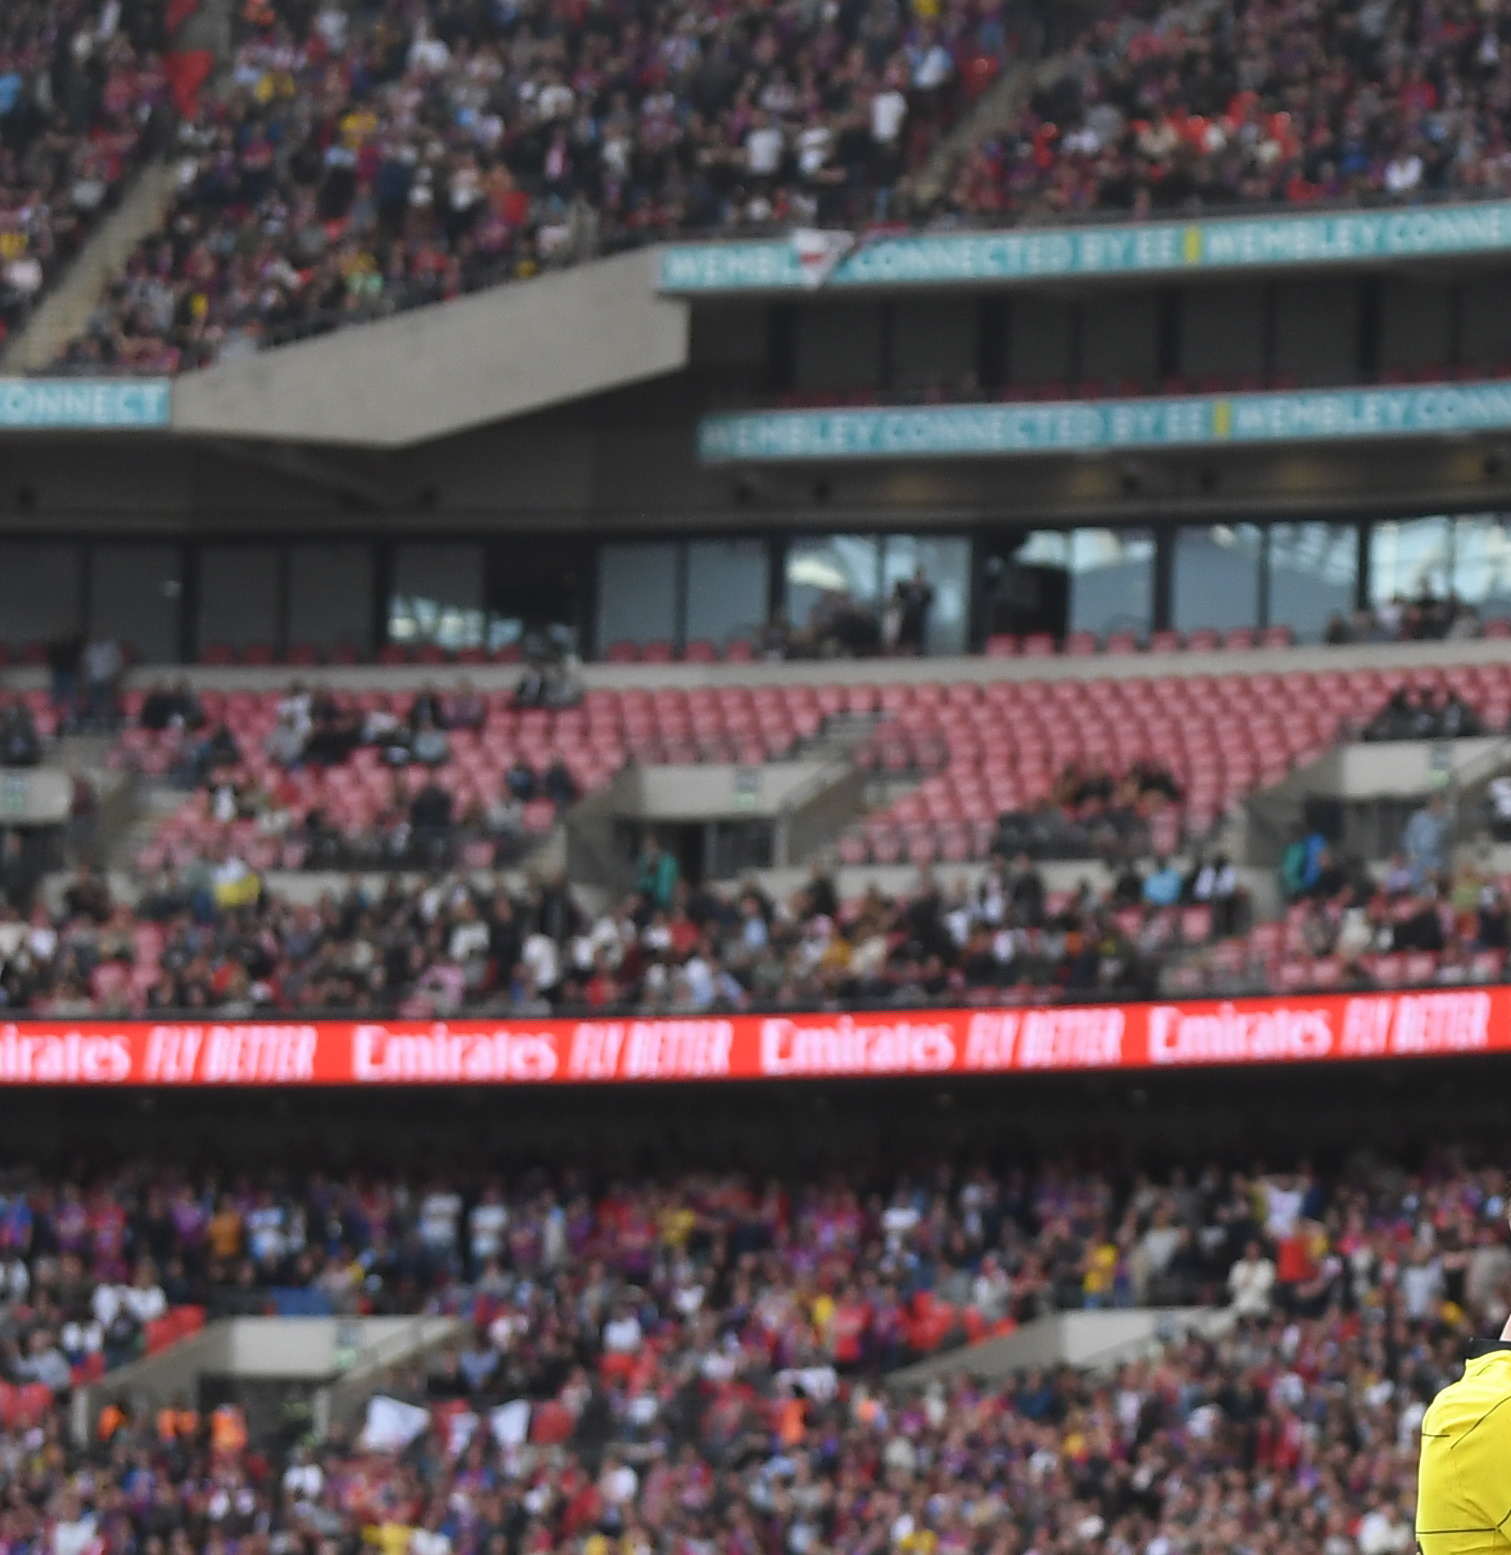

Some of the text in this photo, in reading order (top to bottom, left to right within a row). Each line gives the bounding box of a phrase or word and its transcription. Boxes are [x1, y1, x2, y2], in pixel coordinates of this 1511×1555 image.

[1209, 215, 1384, 261] WEMBLEY
[888, 407, 1105, 451] CONNECTED
[1113, 404, 1160, 442] BY
[1238, 392, 1408, 435] WEMBLEY
[145, 1025, 202, 1082] FLY
[203, 1024, 317, 1082] BETTER
[353, 1020, 733, 1081] Emirates FLY BETTER
[760, 1006, 1125, 1078] Emirates FLY BETTER
[1146, 991, 1491, 1064] Emirates FLY BETTER
